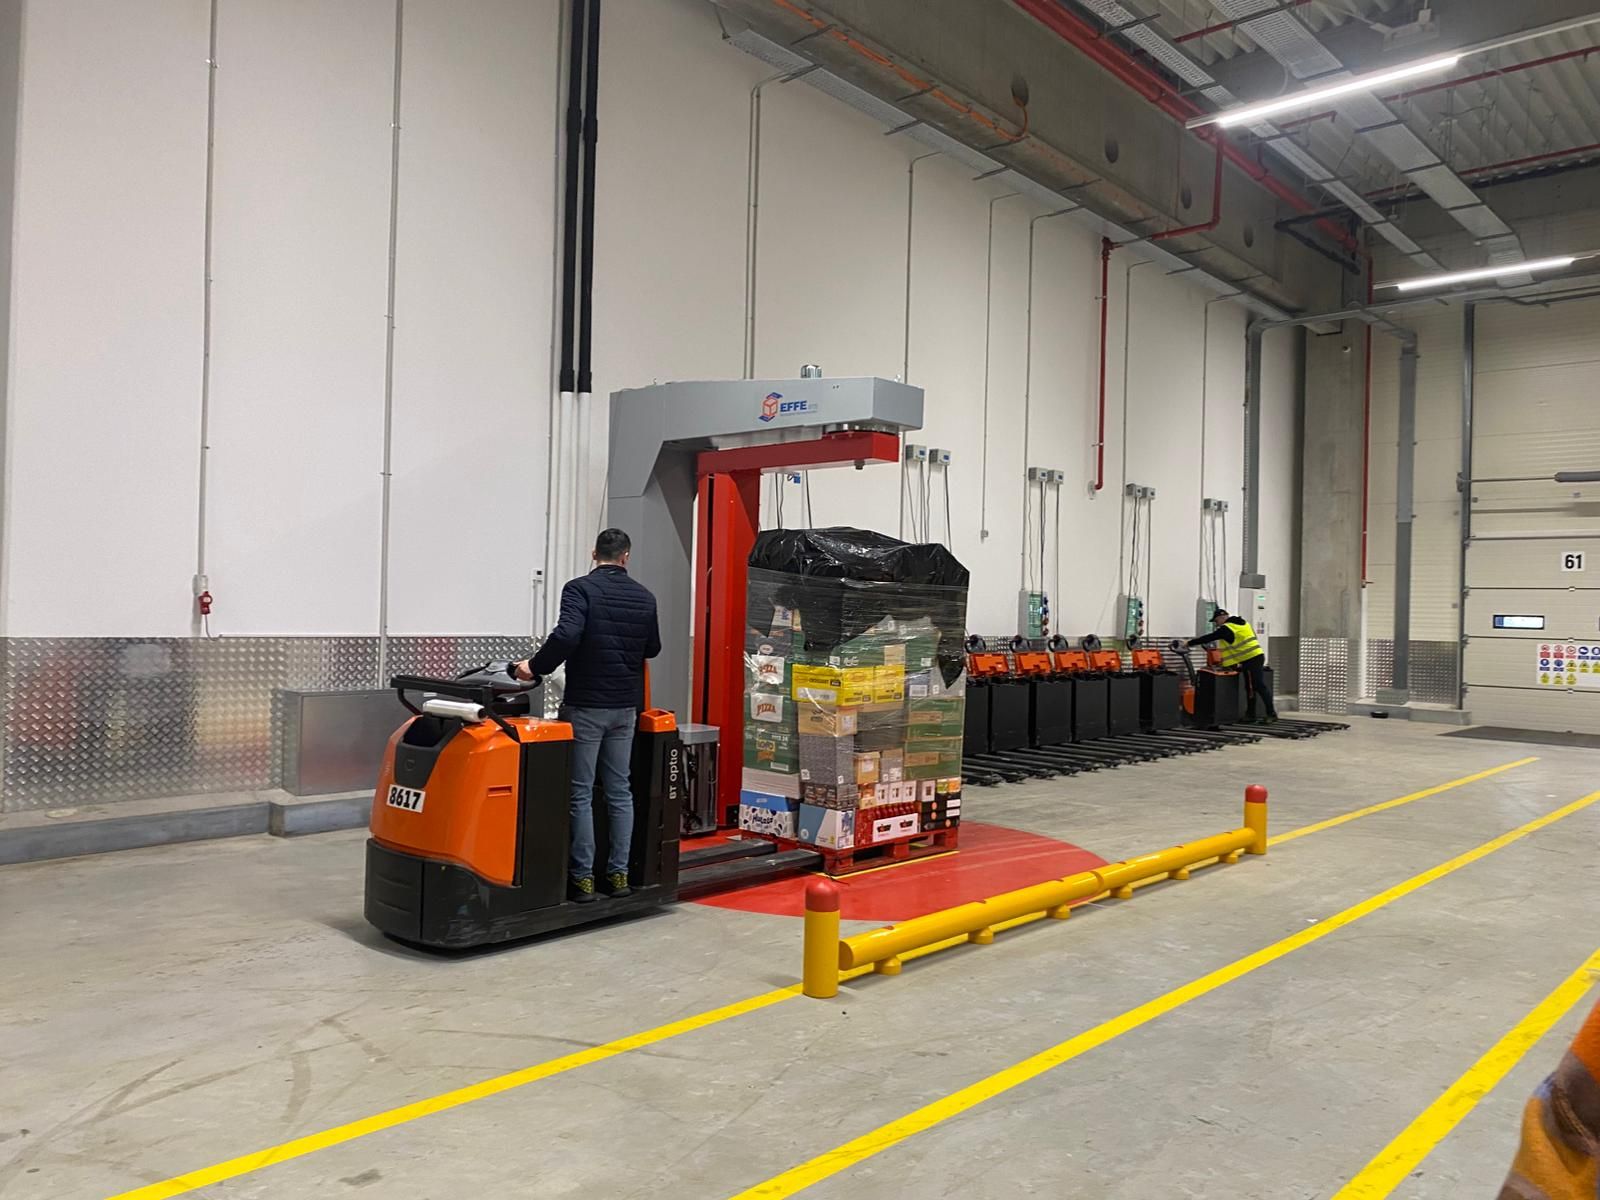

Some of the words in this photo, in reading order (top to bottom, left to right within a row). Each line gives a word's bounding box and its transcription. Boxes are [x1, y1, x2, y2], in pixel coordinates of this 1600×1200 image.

[780, 400, 808, 412] EFFE
[1565, 554, 1582, 569] 61
[756, 703, 777, 716] PIZZA
[389, 786, 422, 810] 8617
[669, 785, 677, 800] BT
